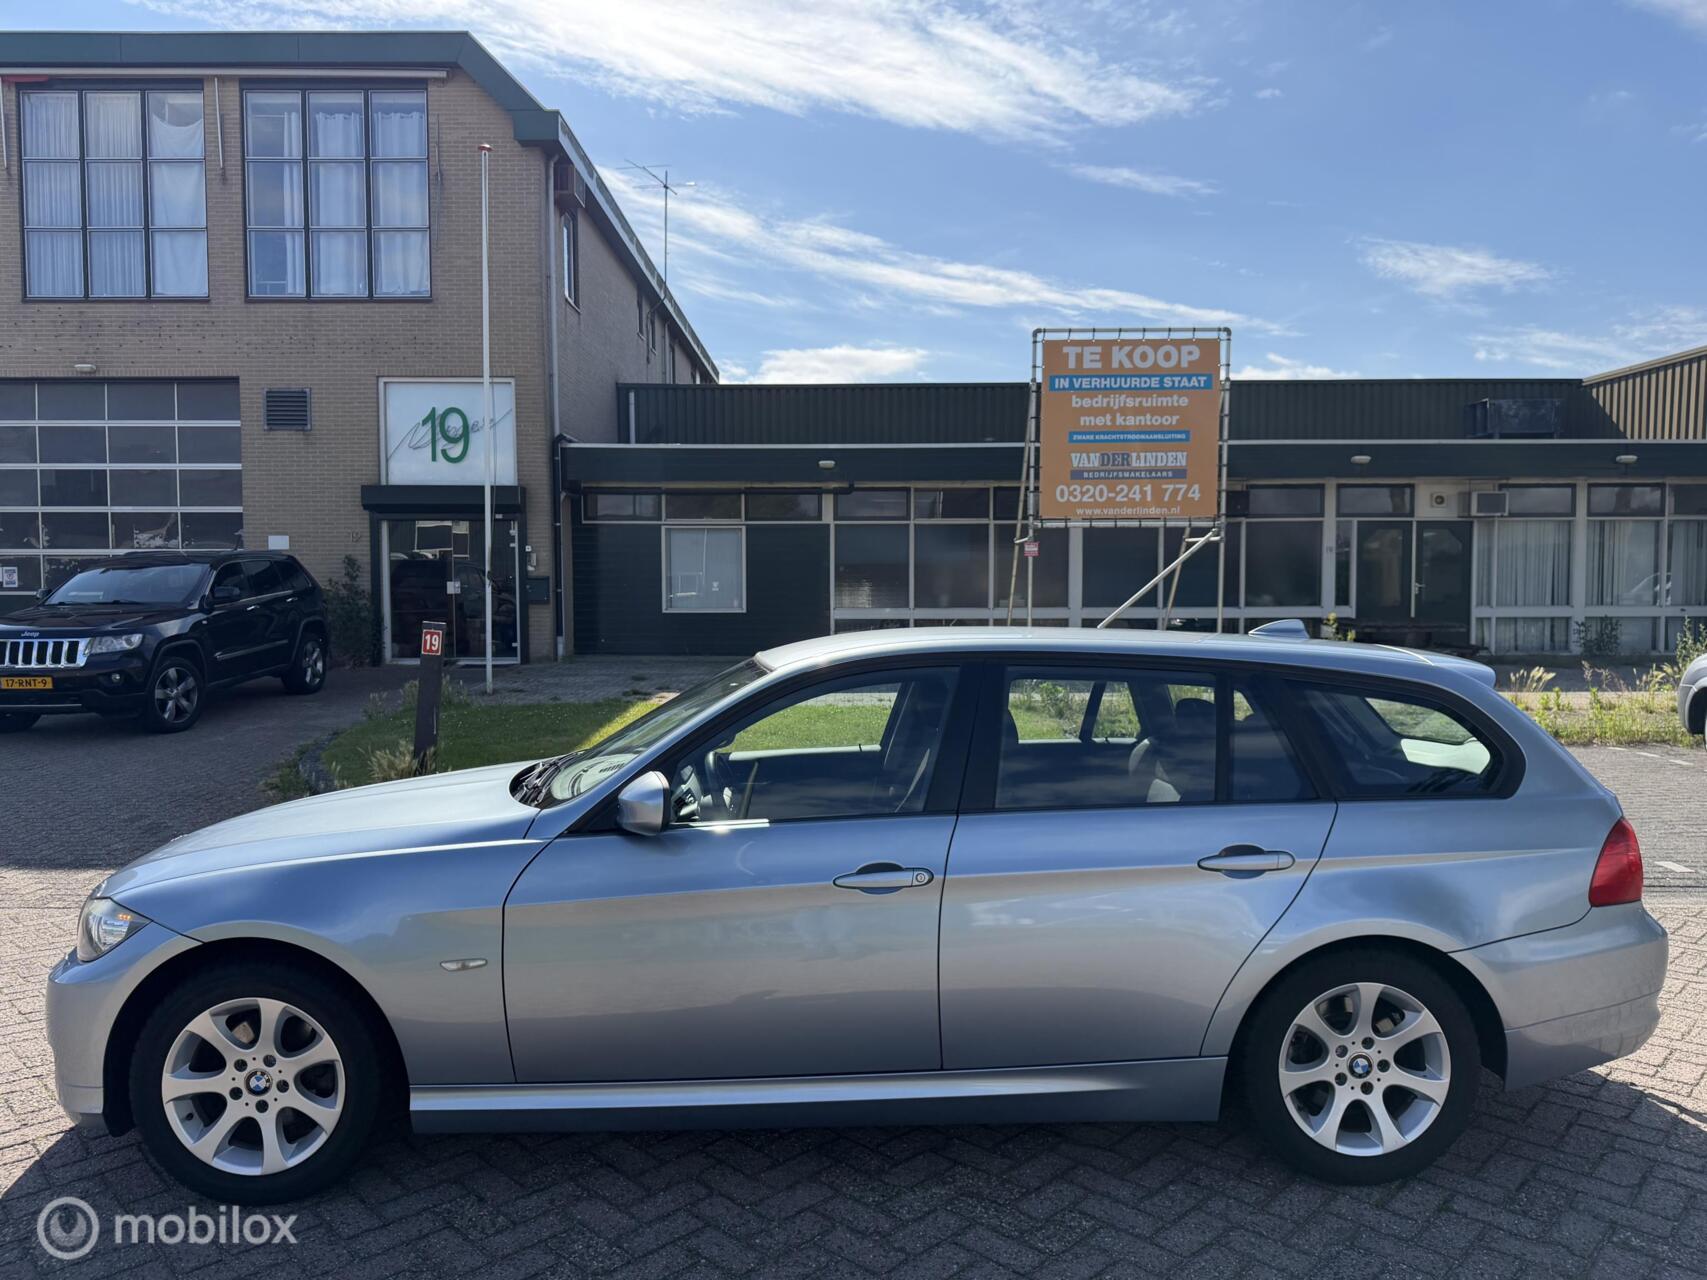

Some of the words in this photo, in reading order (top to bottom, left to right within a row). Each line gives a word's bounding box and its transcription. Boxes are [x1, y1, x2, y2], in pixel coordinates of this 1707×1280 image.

[1062, 346, 1102, 369] TE
[1111, 345, 1200, 368] KOOP
[1055, 378, 1069, 388] IN
[1073, 377, 1160, 388] VERHUURDE
[1163, 376, 1207, 387] STAAT
[1071, 394, 1189, 409] bedrijfsruimte
[1080, 415, 1112, 426] met
[1116, 413, 1180, 425] kantoor
[421, 406, 470, 464] 19
[1055, 484, 1152, 502] 0320-241
[1162, 484, 1201, 501] 774
[1076, 506, 1181, 515] www.vanderlinden.nl
[425, 634, 439, 650] 19
[5, 679, 48, 688] 17-RNT-9
